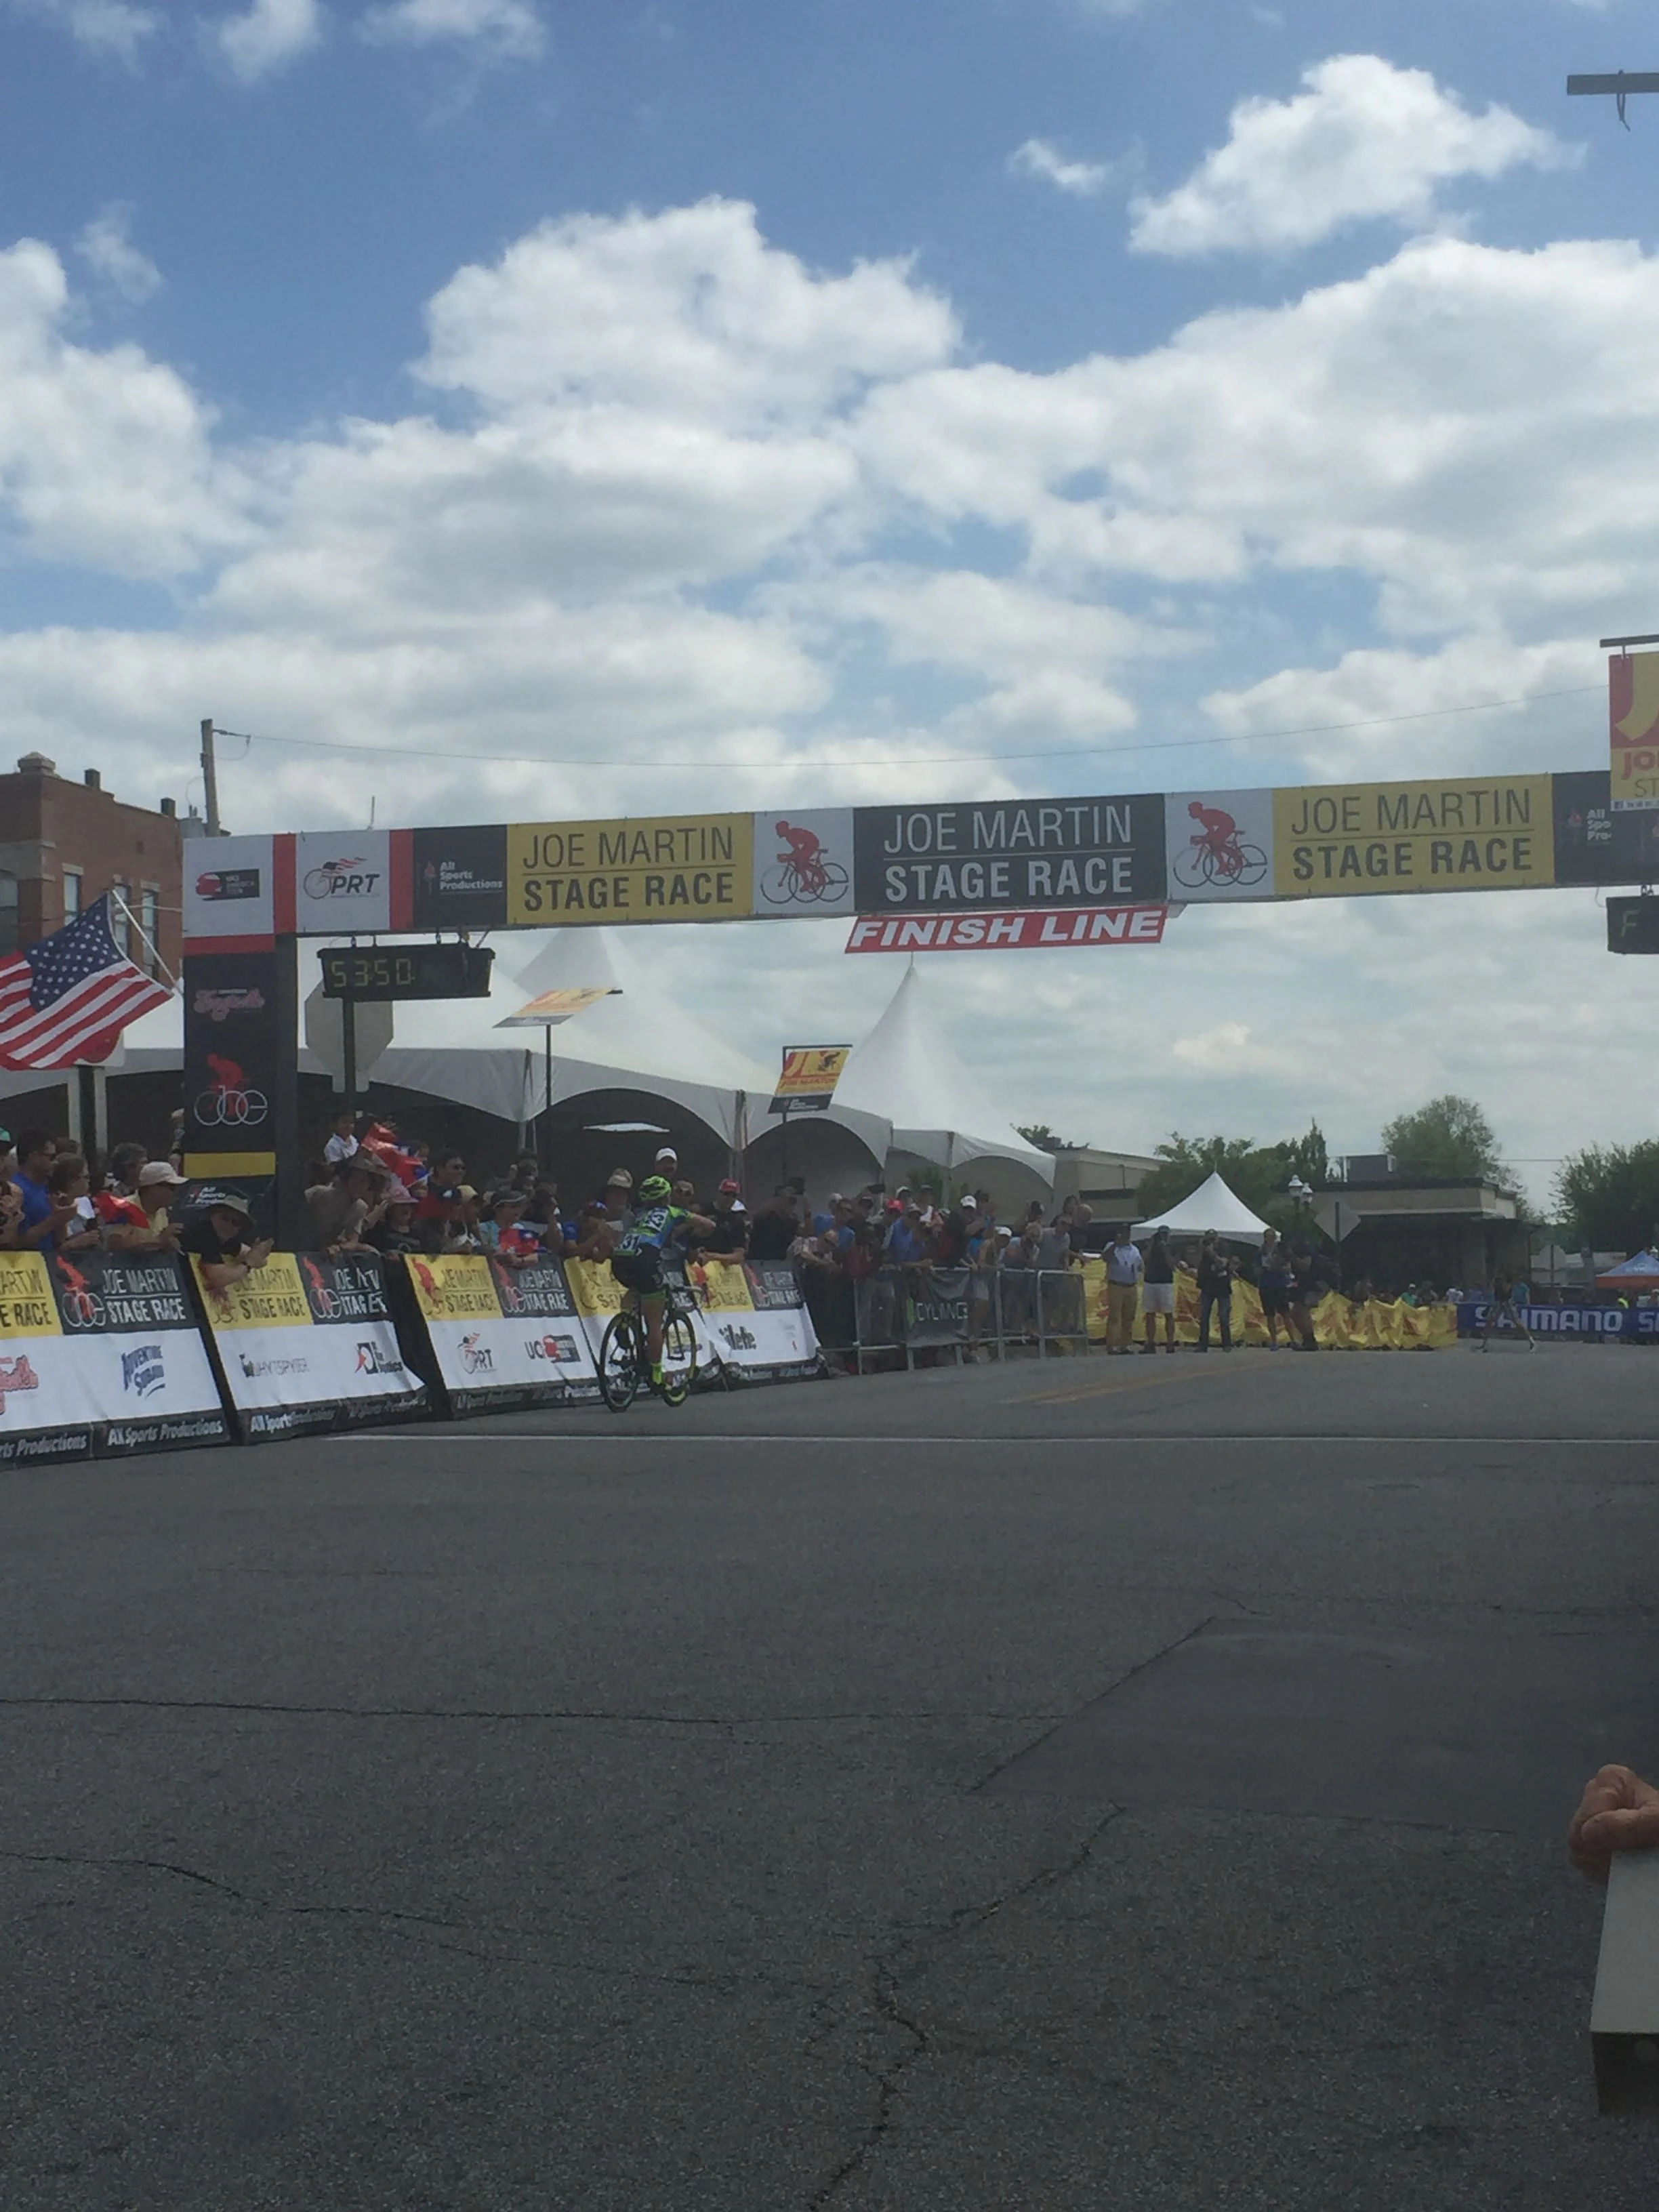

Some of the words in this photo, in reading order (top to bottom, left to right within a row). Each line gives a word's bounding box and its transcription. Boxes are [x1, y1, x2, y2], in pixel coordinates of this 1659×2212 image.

[1622, 751, 1659, 780] JO
[1635, 777, 1659, 798] ST
[1292, 795, 1361, 836] JOE
[1377, 787, 1531, 831] MARTIN
[884, 812, 957, 854] JOE
[972, 804, 1132, 849] MARTIN
[1587, 819, 1612, 831] Spo
[1587, 831, 1612, 840] Pro
[523, 833, 585, 869] JOE
[598, 825, 733, 865] MARTIN
[1292, 842, 1414, 881] STAGE
[1431, 838, 1533, 874] RACE
[439, 861, 455, 871] All
[439, 870, 473, 882] Sports
[331, 874, 380, 894] PRT
[439, 880, 503, 890] Productions
[524, 876, 630, 912] STAGE
[645, 872, 734, 907] RACE
[885, 861, 1010, 903] STAGE
[1028, 857, 1133, 897] RACE
[850, 916, 1027, 948] FINISH
[1039, 910, 1164, 941] LINE
[0, 1269, 43, 1295] ARTIN
[128, 1267, 179, 1292] MARTIN
[14, 1302, 53, 1326] RACE
[108, 1300, 151, 1324] STAGE
[155, 1298, 186, 1321] RACE
